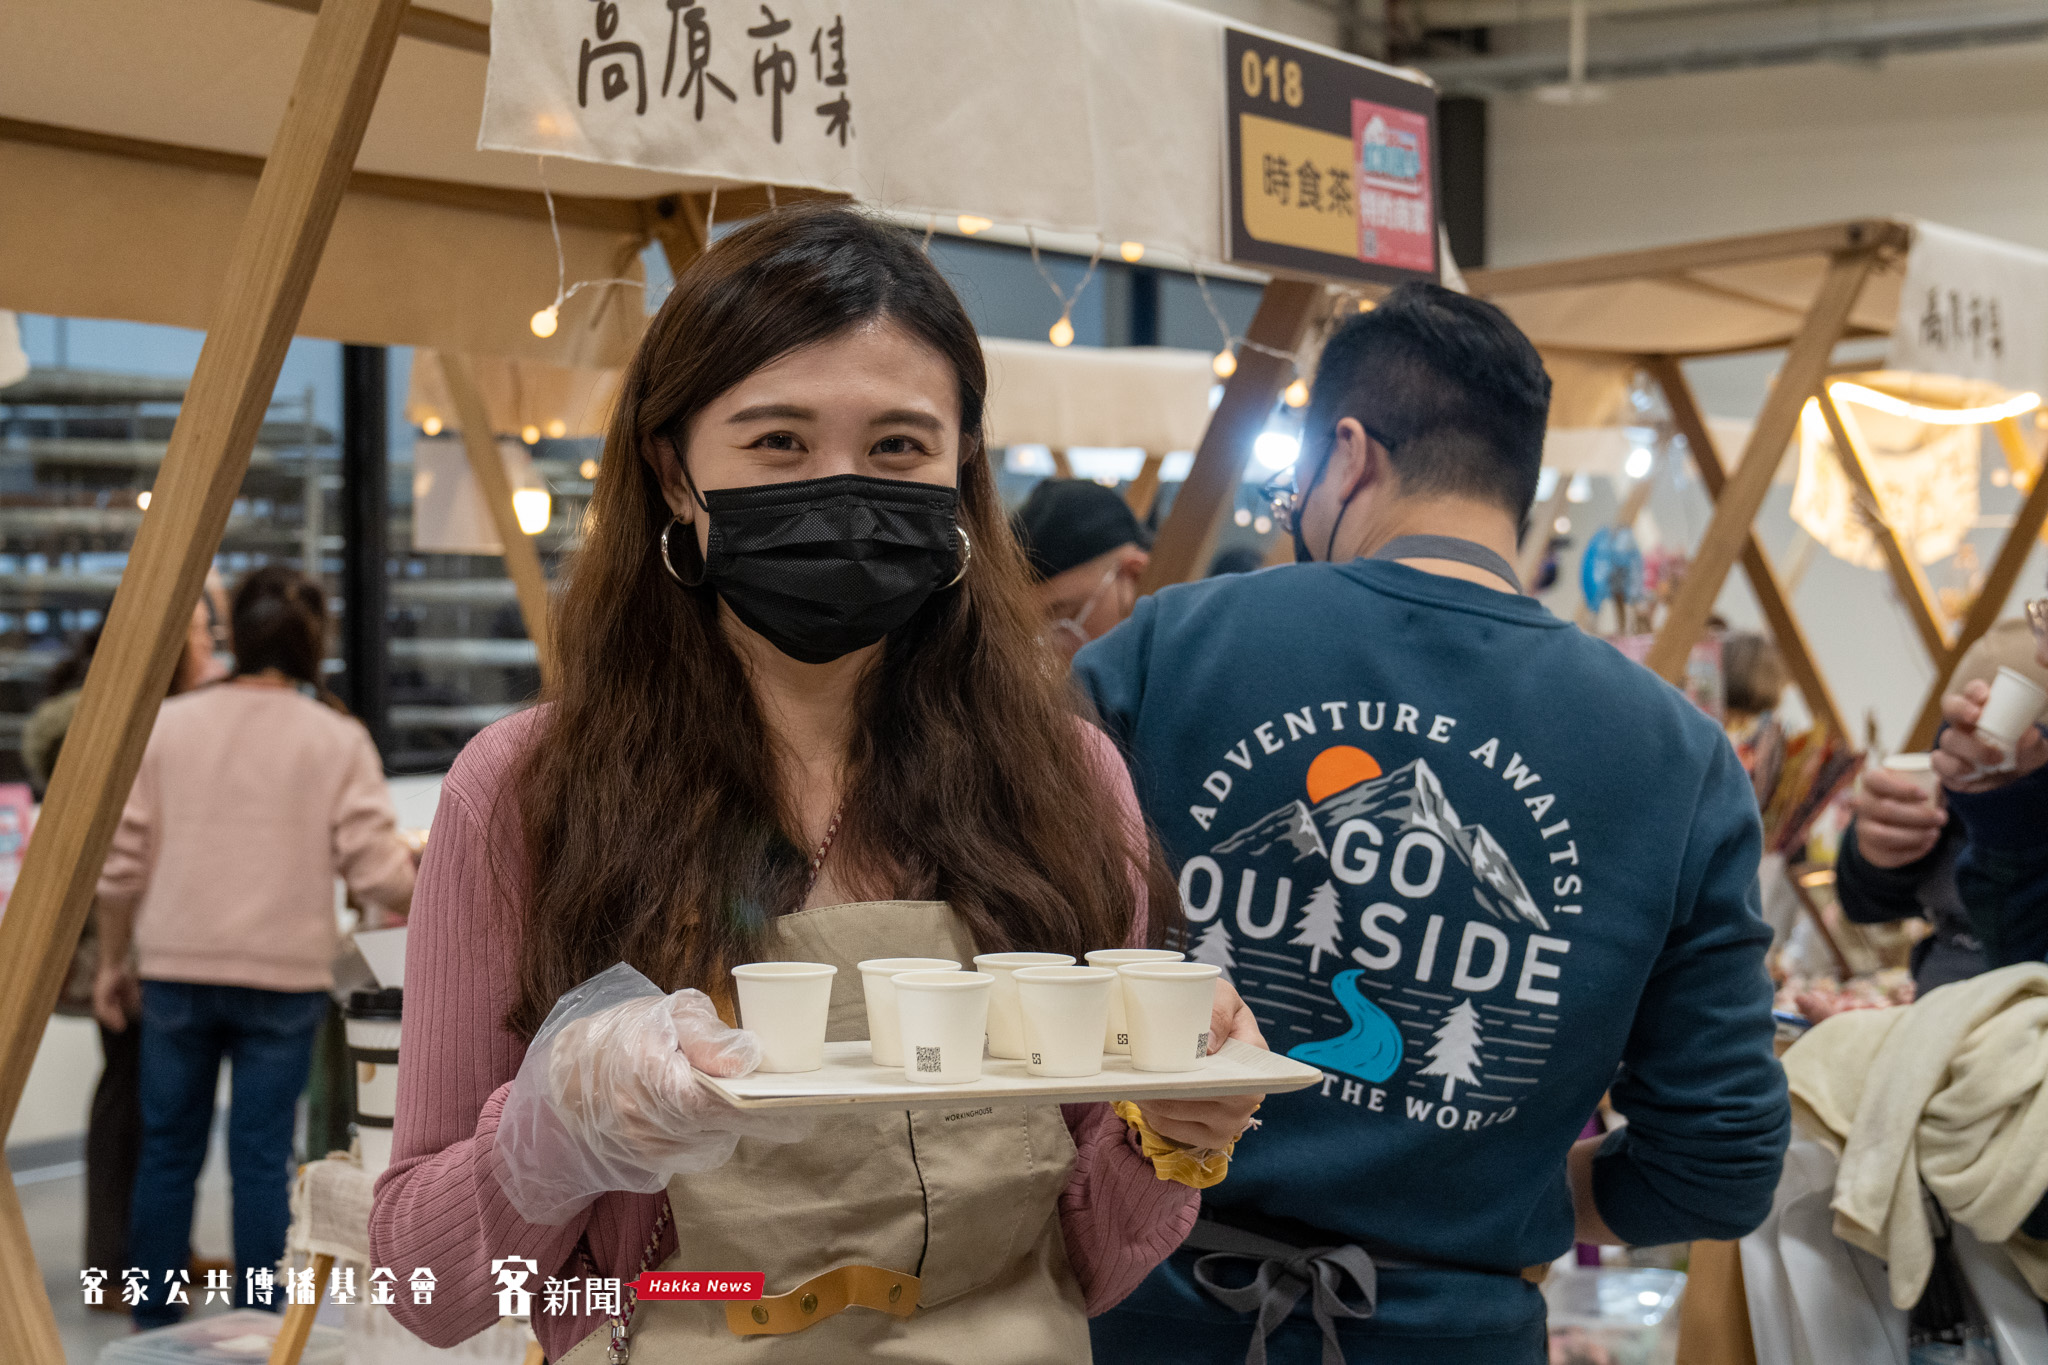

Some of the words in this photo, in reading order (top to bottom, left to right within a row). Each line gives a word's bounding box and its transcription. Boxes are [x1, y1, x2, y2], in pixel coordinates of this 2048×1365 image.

[1241, 49, 1303, 107] 018
[1189, 701, 1456, 831] ADVENTURE
[1469, 737, 1582, 914] AWAITS!
[1330, 818, 1446, 898] GO
[944, 1107, 993, 1122] WORKINGHOUSE
[1320, 1072, 1388, 1112] THE
